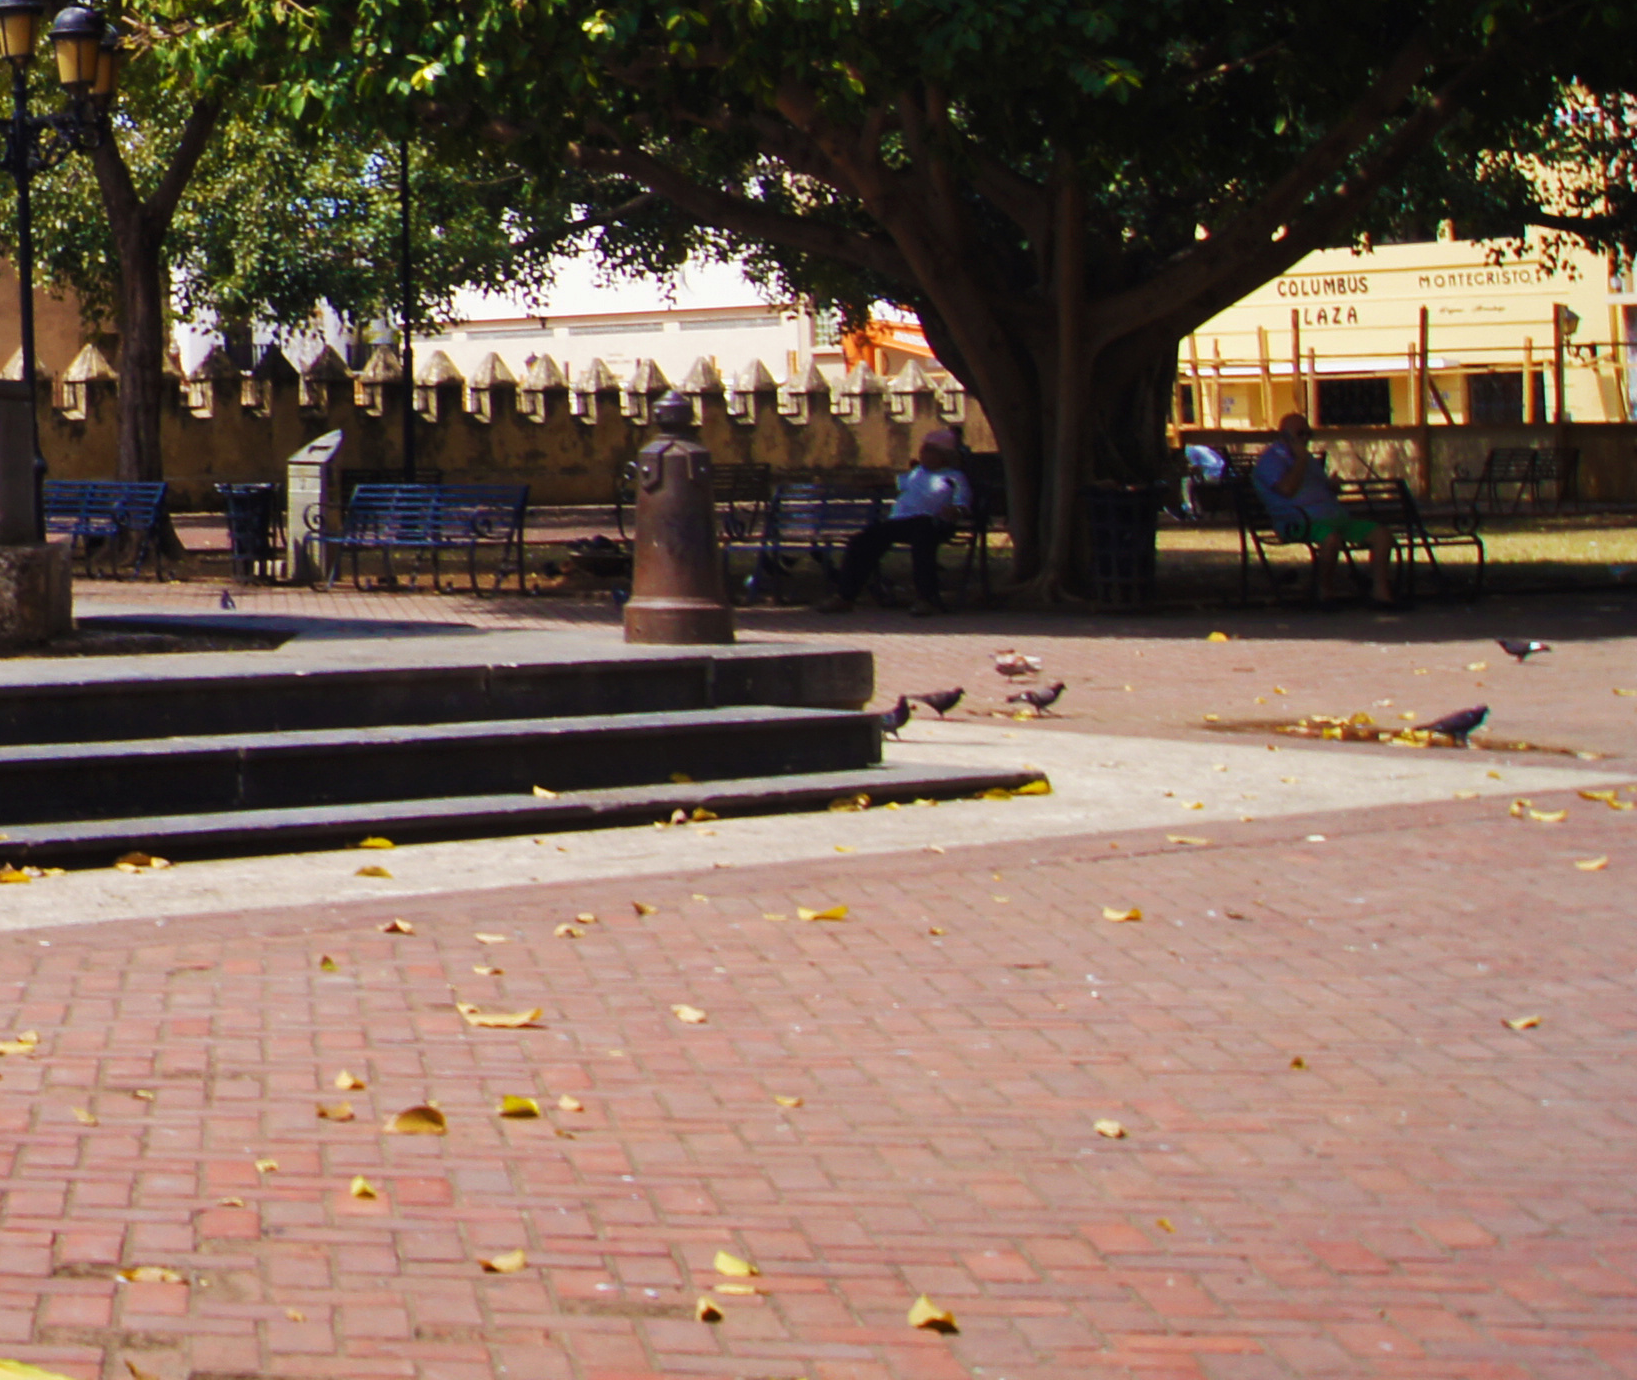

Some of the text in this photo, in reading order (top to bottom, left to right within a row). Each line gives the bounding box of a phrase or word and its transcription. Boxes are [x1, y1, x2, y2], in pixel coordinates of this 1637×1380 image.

[1277, 275, 1368, 297] COLUMBUS
[1419, 269, 1530, 288] MONTECRISTO
[1292, 305, 1358, 325] LAZA
